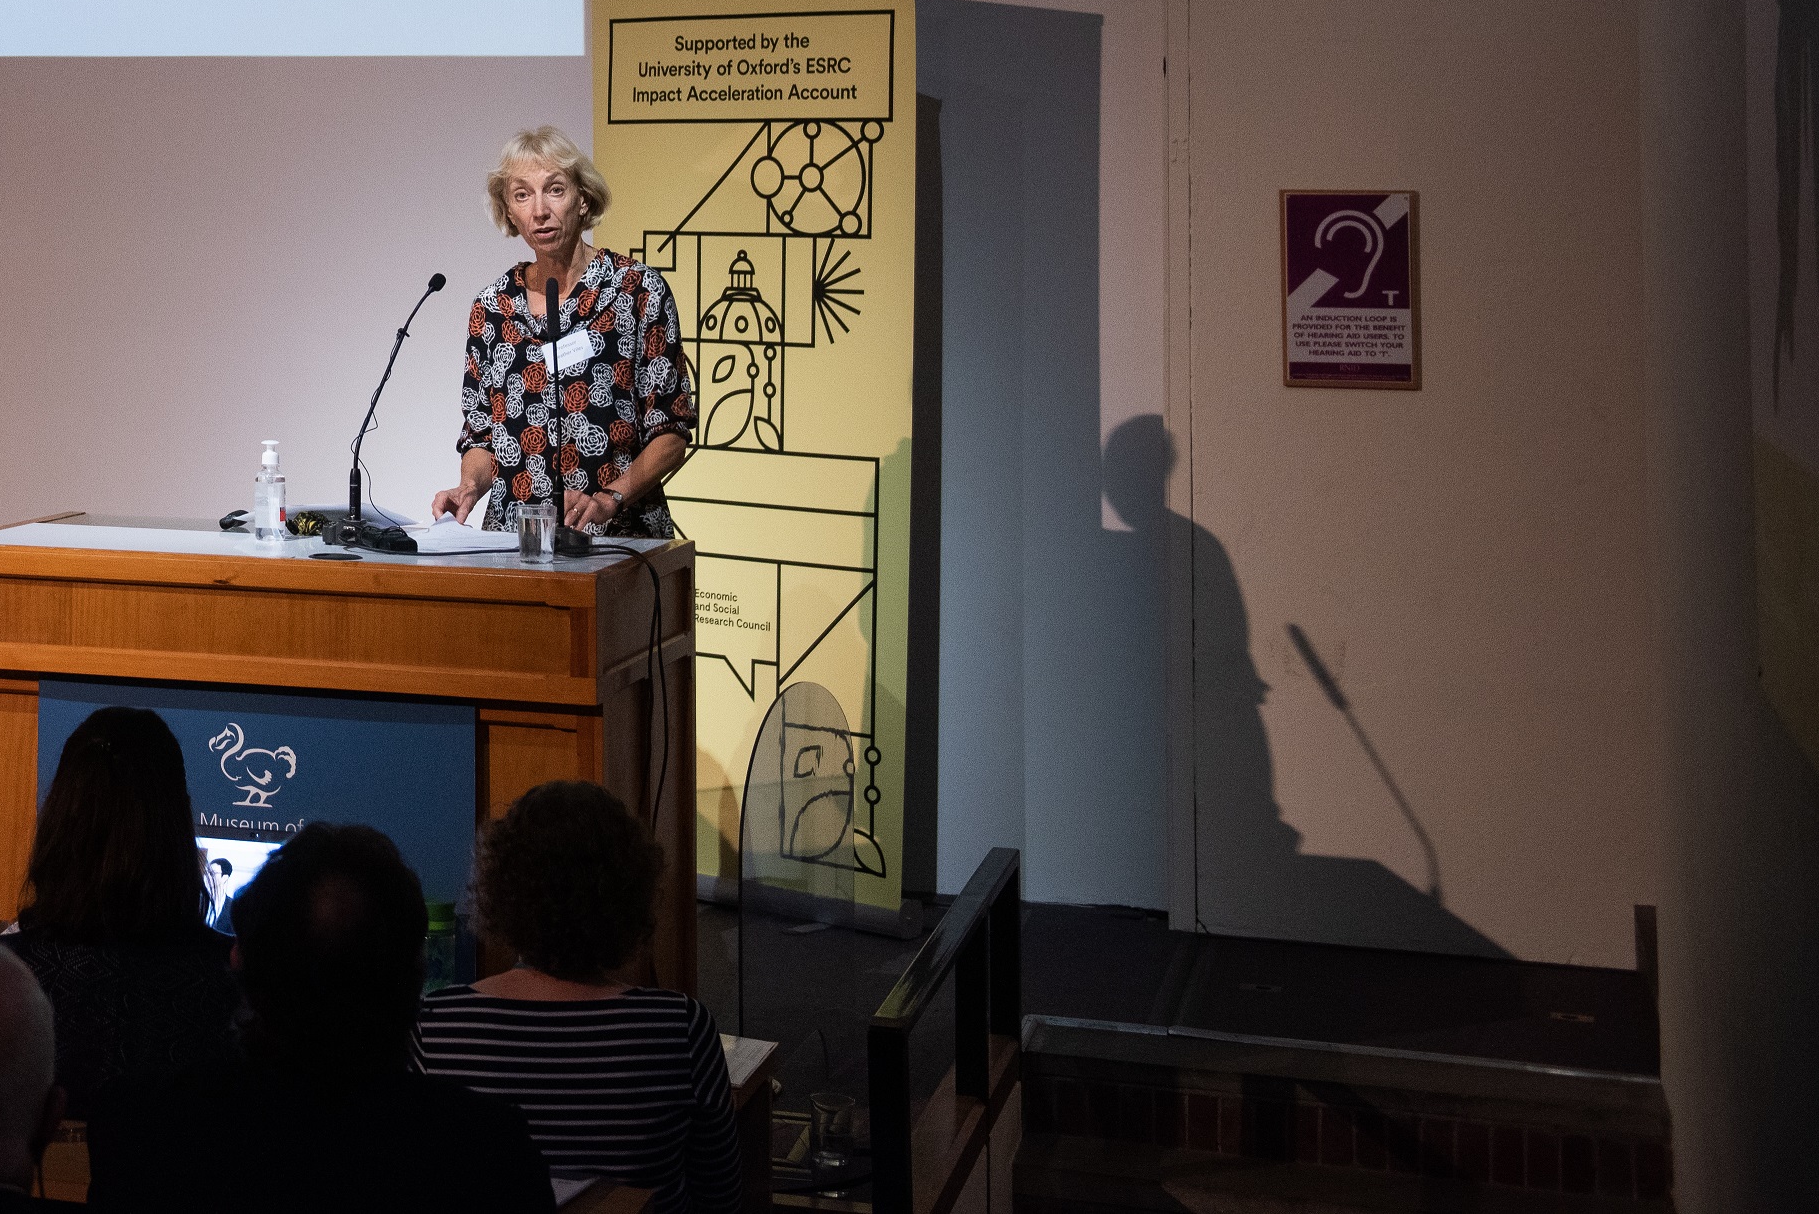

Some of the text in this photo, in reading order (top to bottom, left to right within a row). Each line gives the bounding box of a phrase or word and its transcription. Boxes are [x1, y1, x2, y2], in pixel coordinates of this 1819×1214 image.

[675, 32, 810, 54] Supported by the
[638, 57, 851, 79] University of Oxford's ESRC
[632, 83, 857, 106] Impact Acceleration Account
[1382, 290, 1399, 306] T
[1315, 315, 1362, 323] INDUCTION
[1372, 324, 1406, 332] BENEFIT
[1295, 340, 1311, 348] USE
[1345, 341, 1378, 349] SWITCH
[1308, 349, 1345, 357] HEARING
[695, 589, 738, 602] Economic
[695, 602, 740, 615] and Social
[695, 614, 771, 632] Research Council
